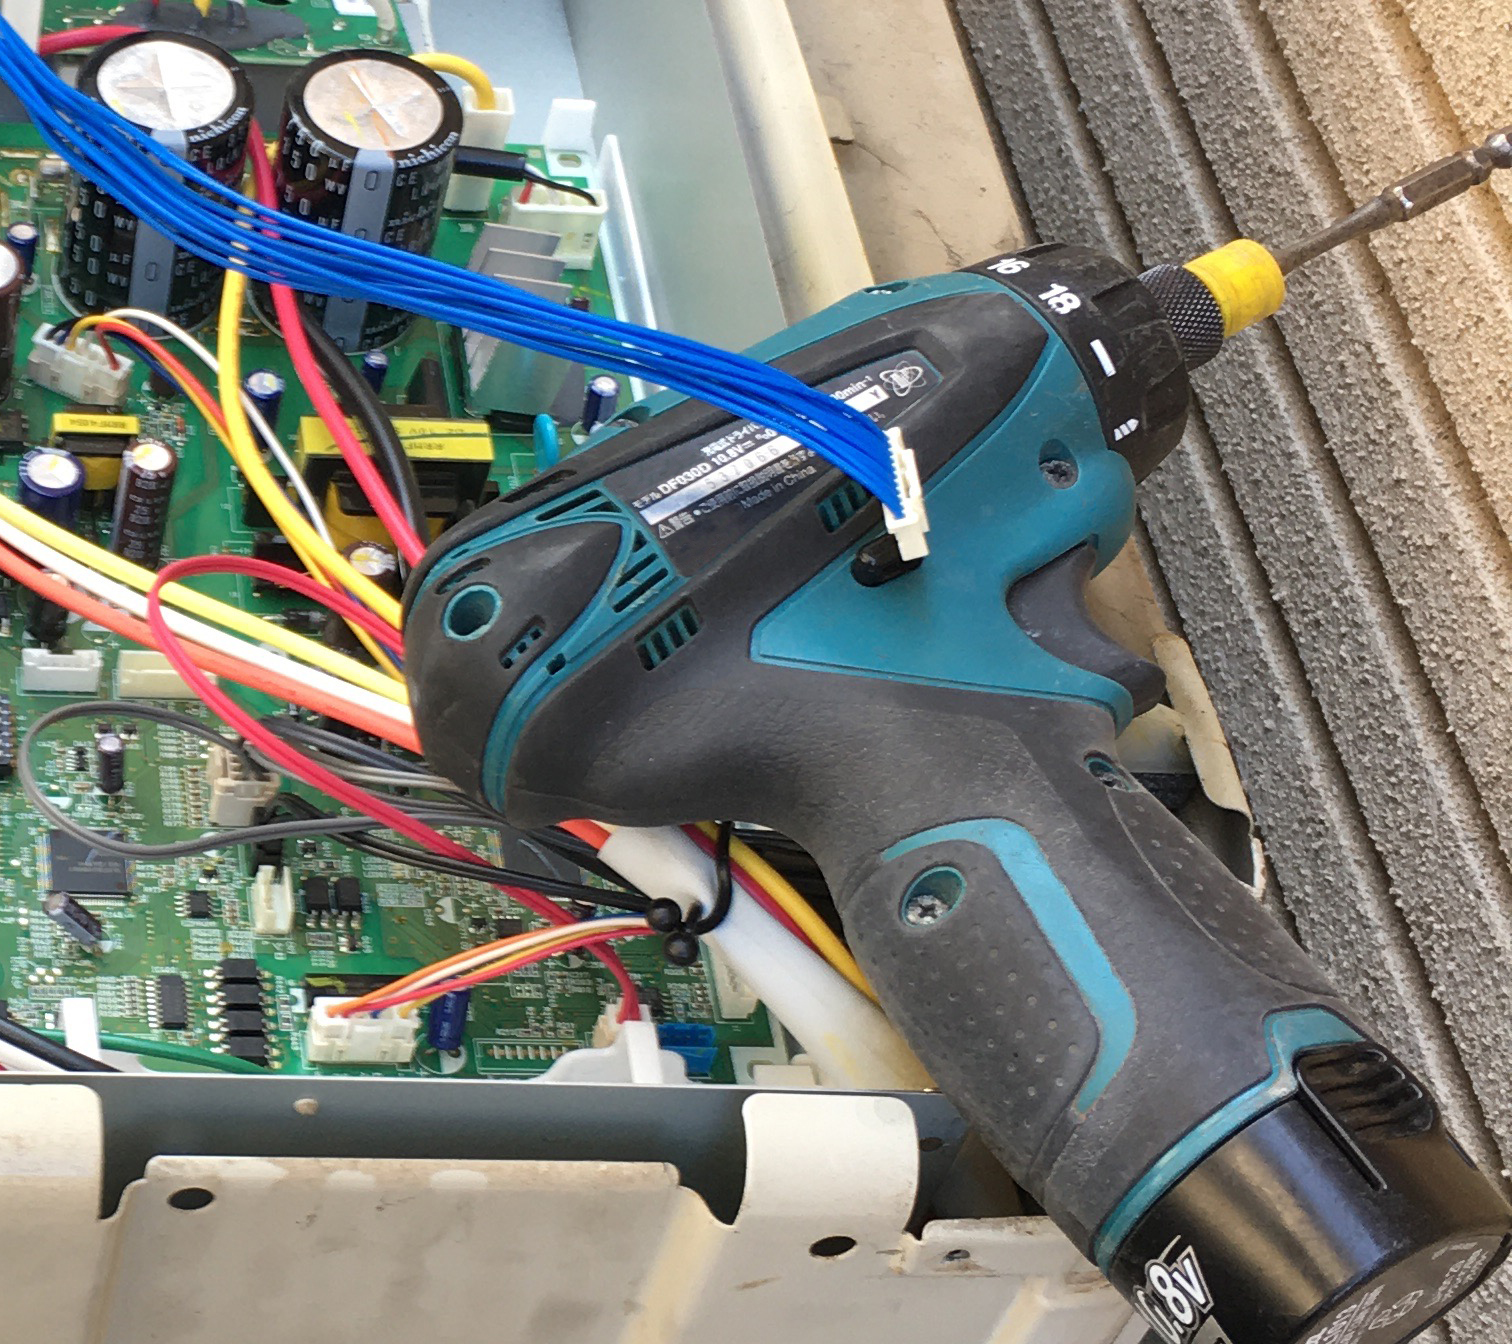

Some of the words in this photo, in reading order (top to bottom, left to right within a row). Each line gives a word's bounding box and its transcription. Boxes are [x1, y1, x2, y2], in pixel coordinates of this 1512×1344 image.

[395, 130, 459, 169] nichicon
[986, 257, 1030, 275] 16
[1038, 283, 1081, 315] 18
[658, 460, 713, 497] DF030D
[740, 486, 773, 510] Made
[771, 480, 783, 493] in
[783, 463, 817, 487] China
